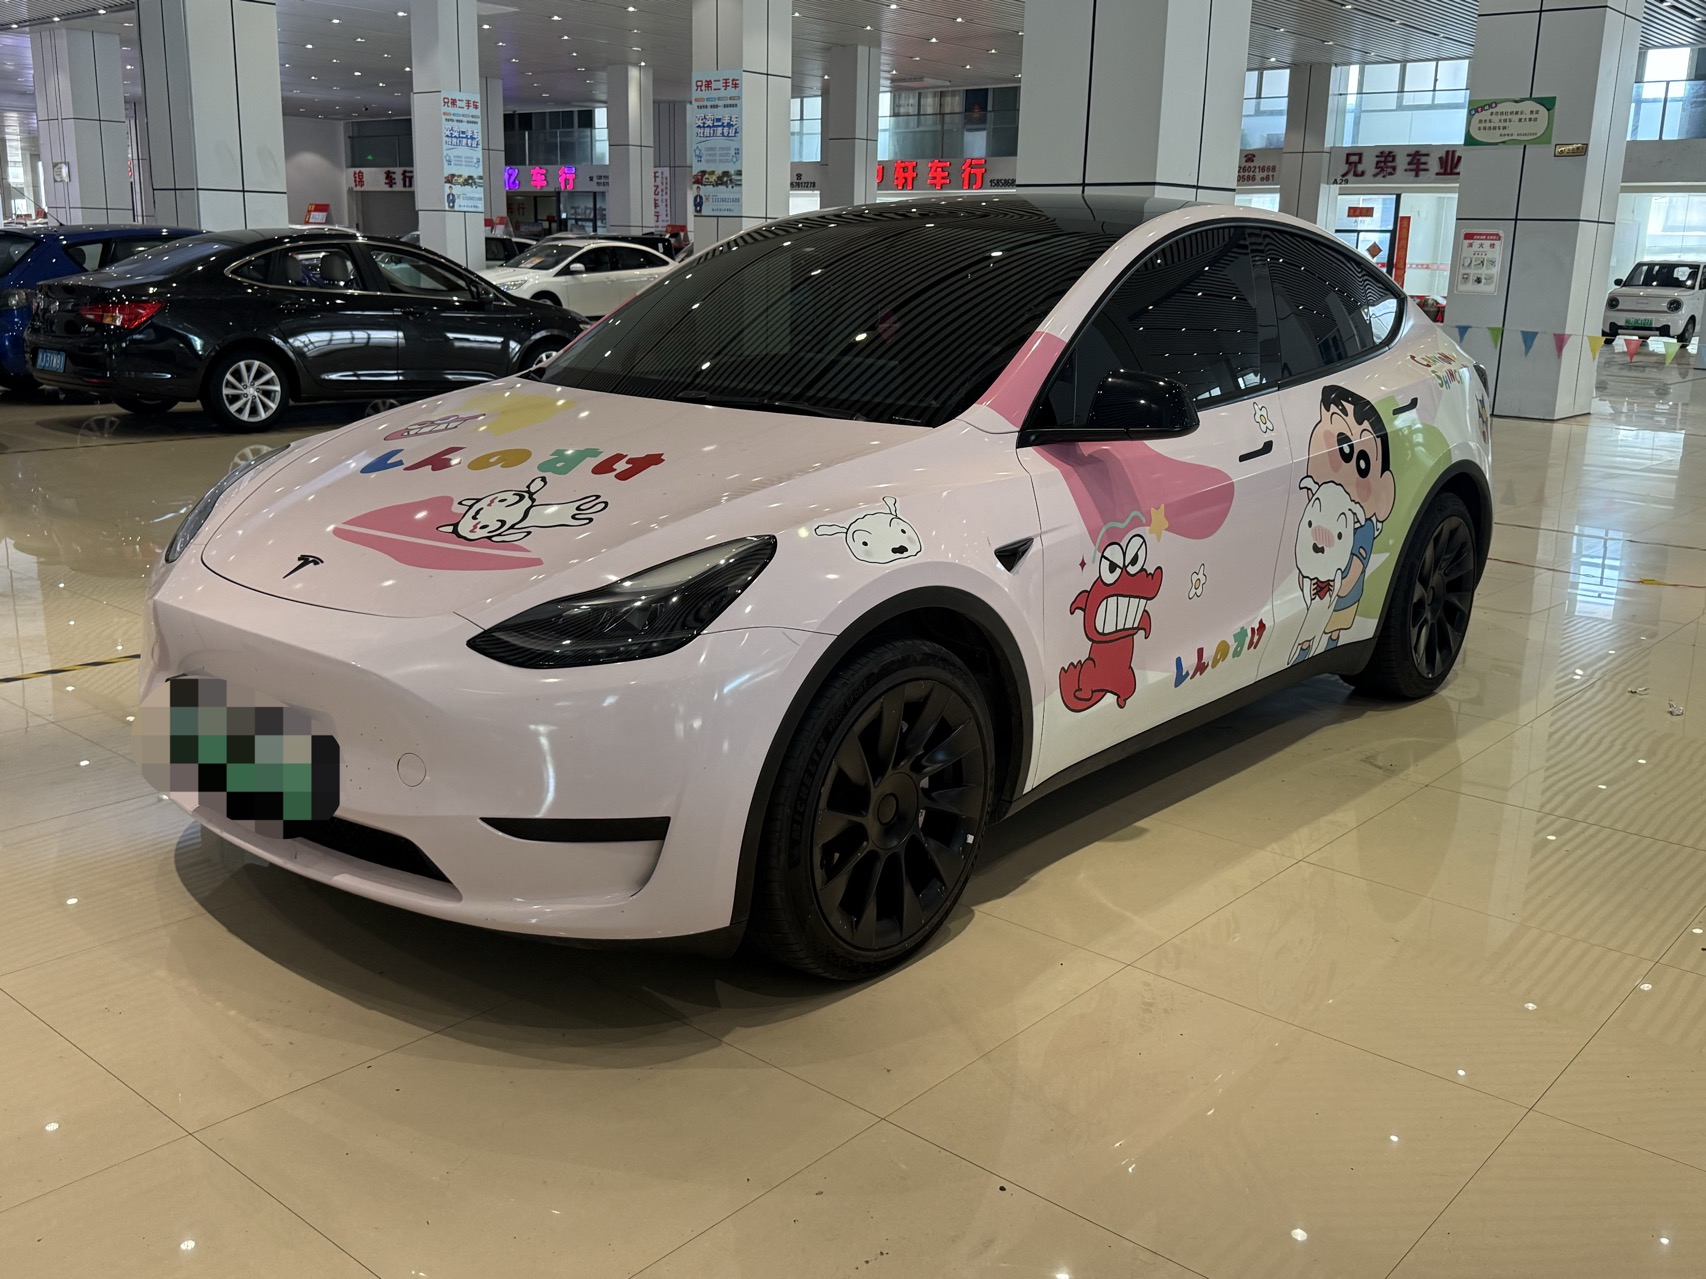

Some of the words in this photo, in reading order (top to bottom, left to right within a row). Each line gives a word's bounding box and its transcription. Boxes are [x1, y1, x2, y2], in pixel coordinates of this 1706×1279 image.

[695, 78, 740, 92] 兄弟二手车
[442, 97, 480, 110] 兄弟二手车
[1340, 150, 1462, 178] 兄弟车业
[384, 170, 413, 188] 车行
[360, 446, 666, 481] しんのすけ
[1174, 618, 1266, 688] しんのすけ
